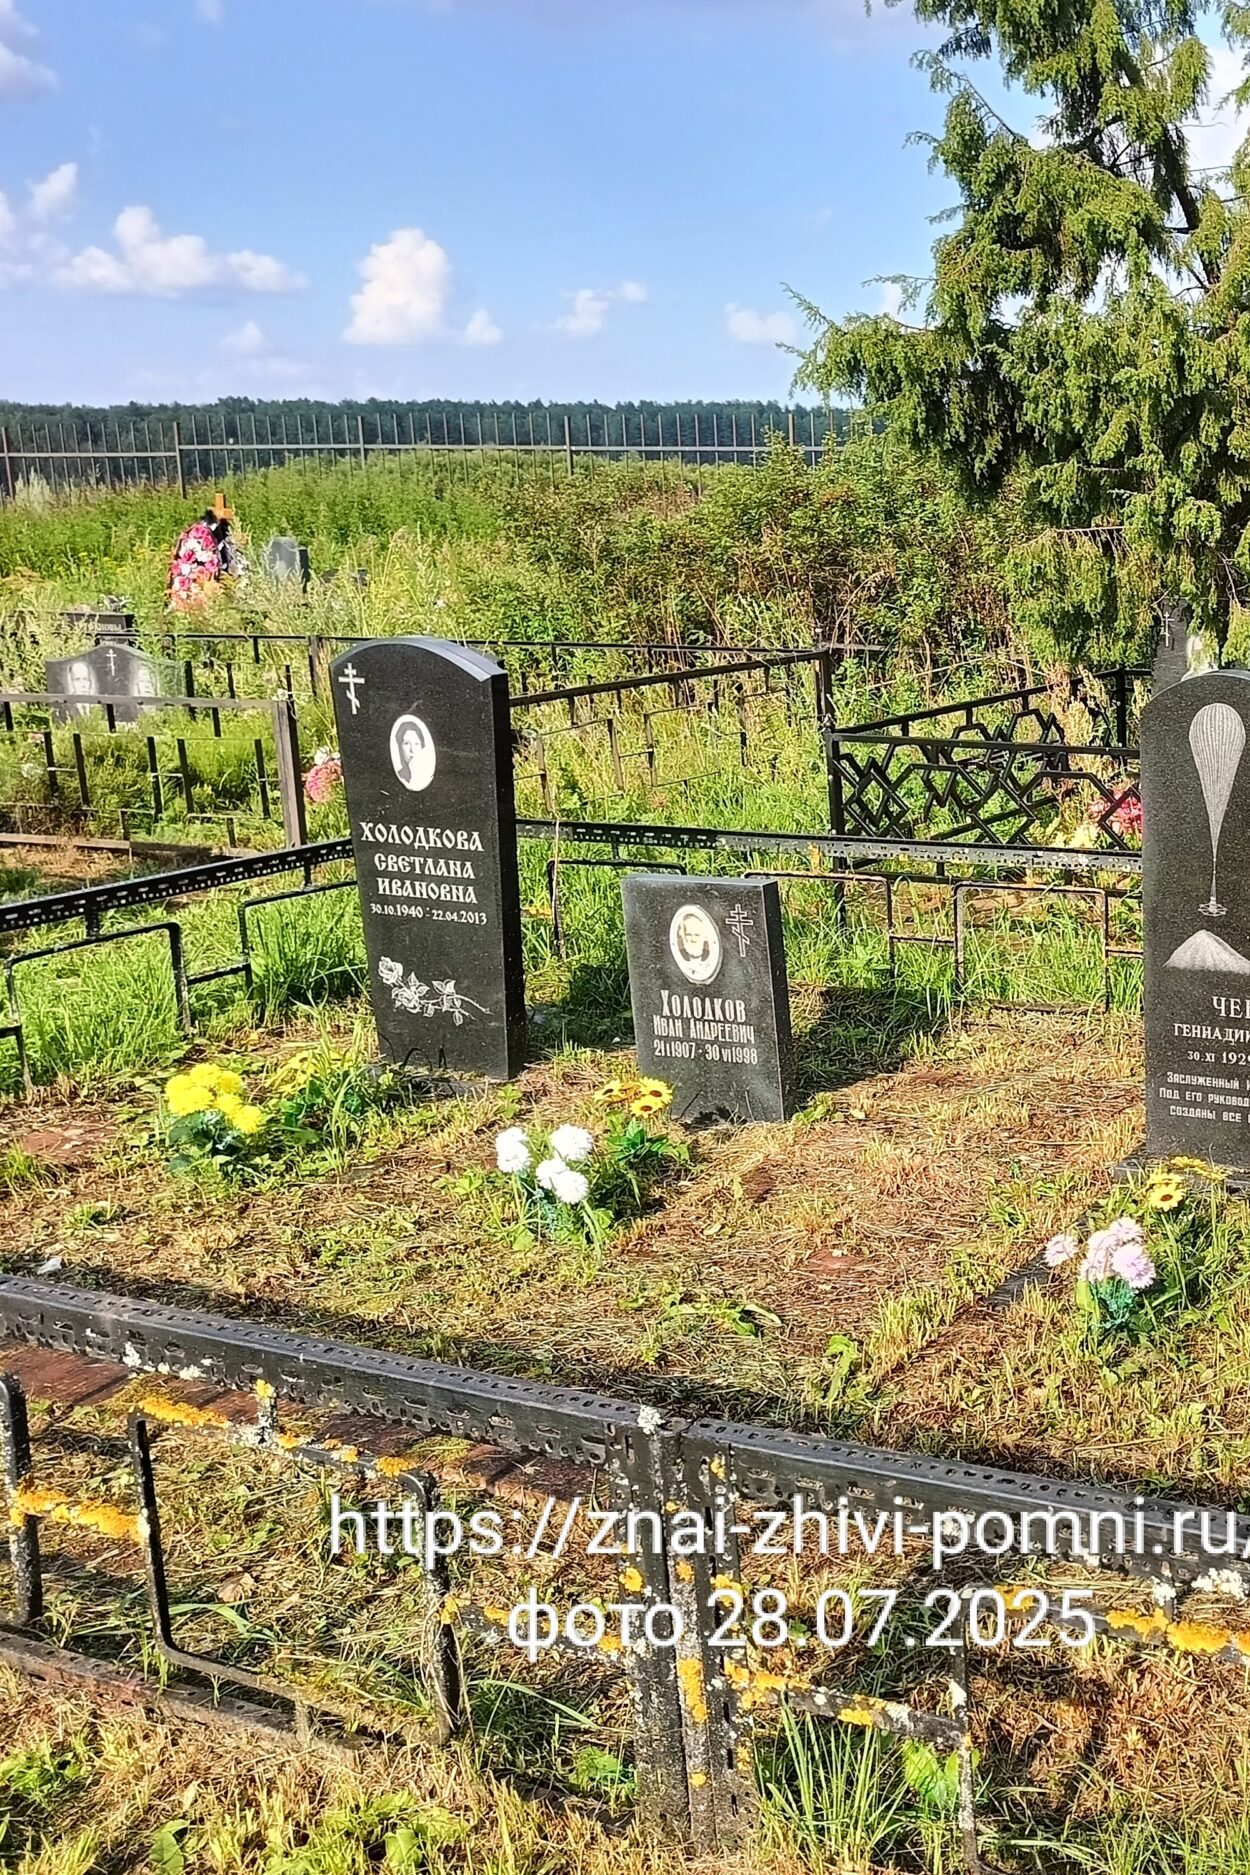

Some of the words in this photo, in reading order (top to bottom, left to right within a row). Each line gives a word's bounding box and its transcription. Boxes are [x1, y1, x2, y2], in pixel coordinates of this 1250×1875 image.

[360, 821, 485, 852] ХОЛОДКОВА
[373, 853, 476, 879] СВЕТЛАНА
[376, 877, 478, 904] ИВАНОВНА
[370, 903, 424, 918] 30.10.1940
[431, 909, 487, 925] 22.04.2013
[660, 989, 746, 1023] ХОЛОДКОВ
[653, 1014, 683, 1038] ИВАН
[1185, 1091, 1203, 1103] ЕГО
[1170, 1105, 1216, 1120] СОЗДАНЫ
[1222, 1111, 1243, 1123] ВСЕ
